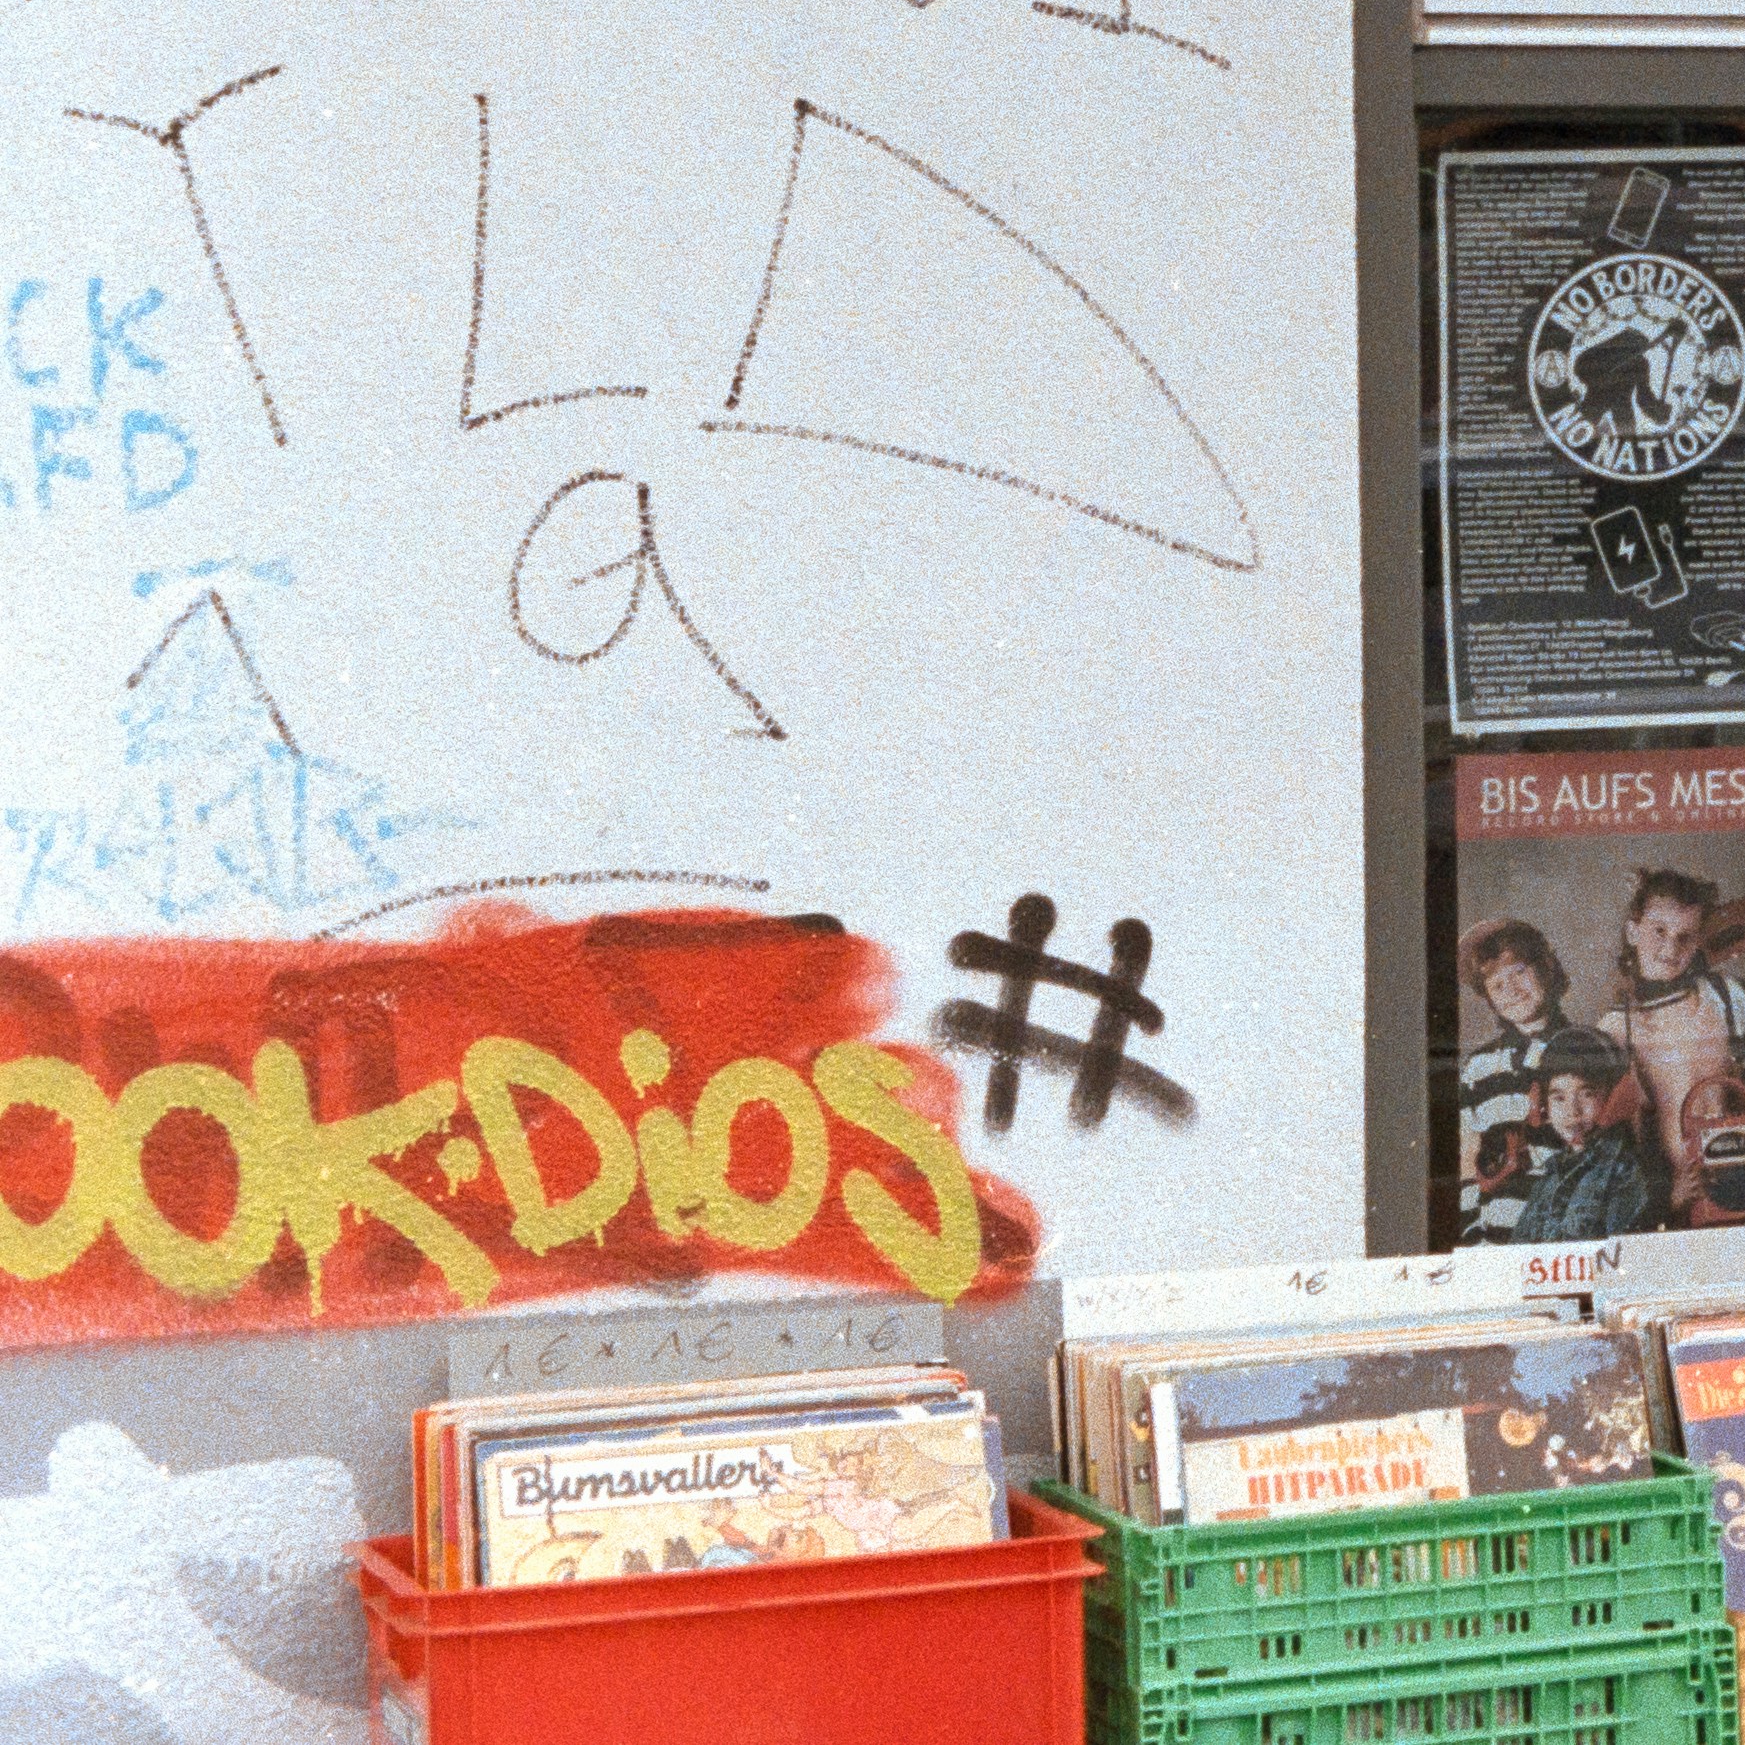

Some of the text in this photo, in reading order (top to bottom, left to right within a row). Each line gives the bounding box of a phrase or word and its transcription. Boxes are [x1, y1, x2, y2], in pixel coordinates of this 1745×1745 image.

[1550, 262, 1729, 334] NO BORDERS
[1547, 398, 1732, 473] NO NATIONS
[1479, 773, 1542, 816] BIS
[1551, 770, 1658, 814] AUFS
[1697, 1378, 1738, 1414] Die
